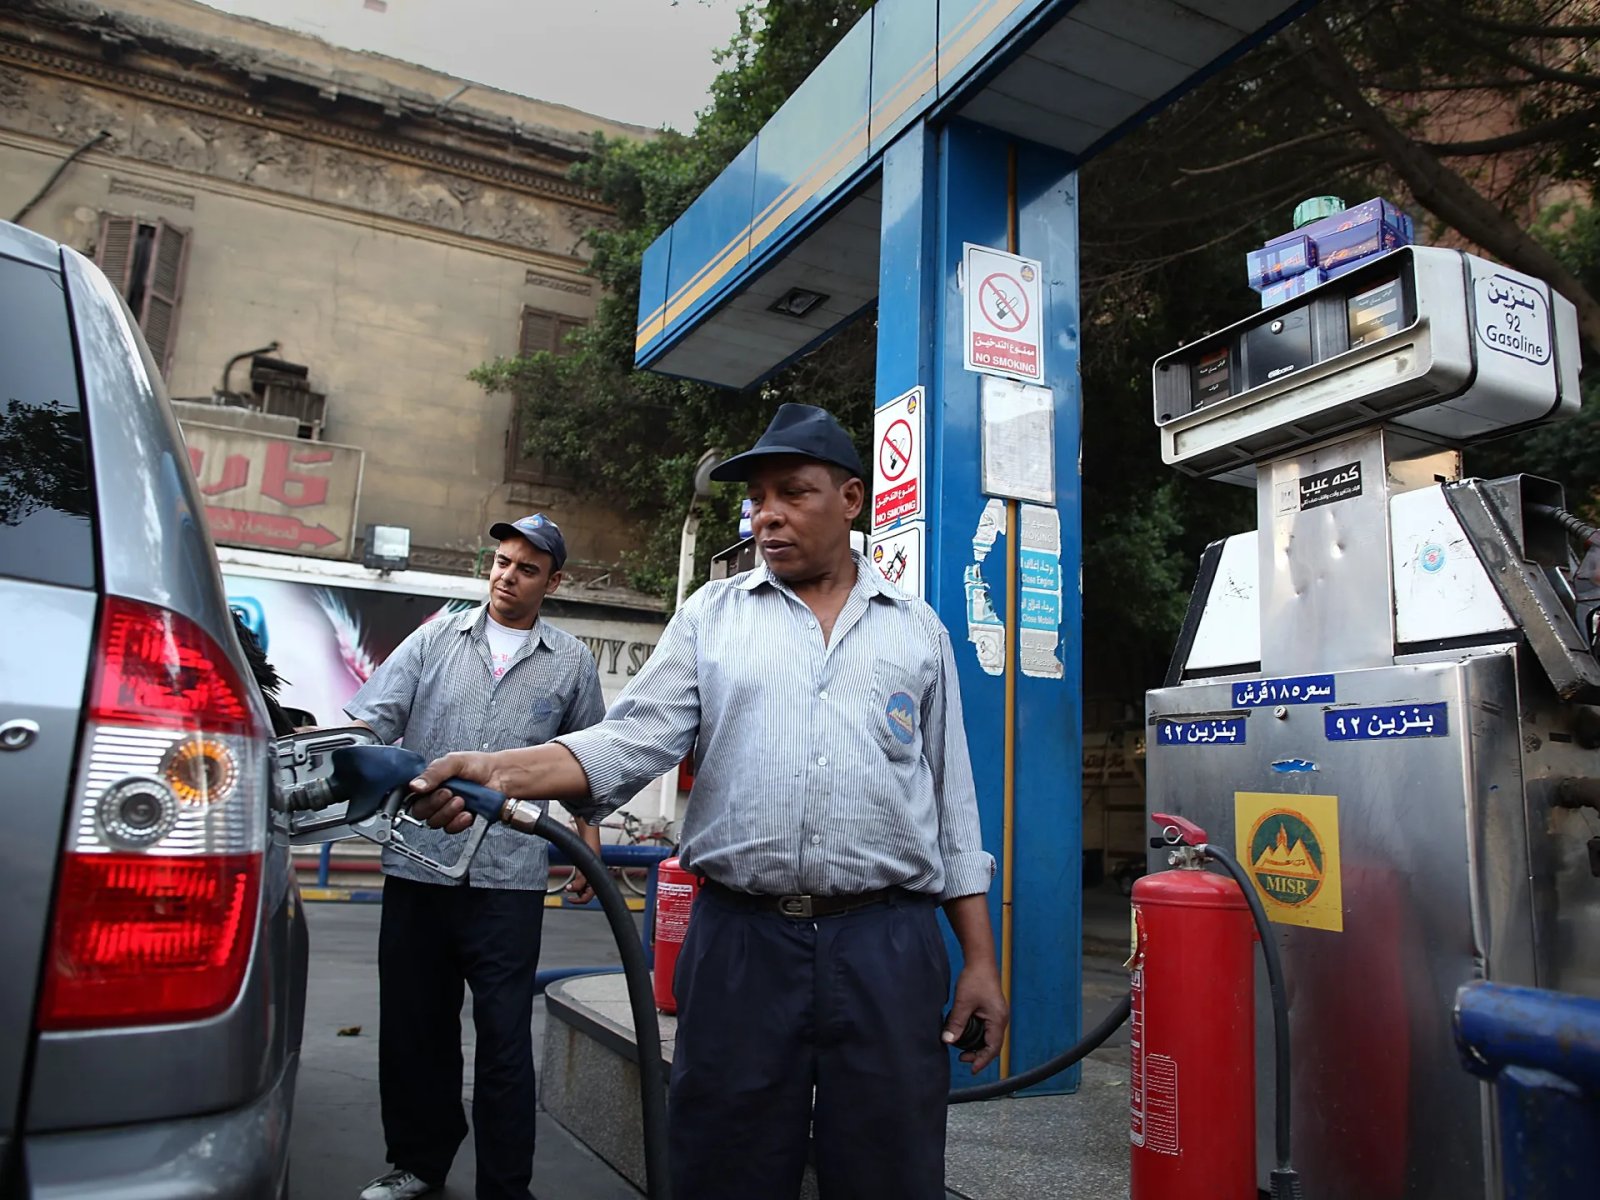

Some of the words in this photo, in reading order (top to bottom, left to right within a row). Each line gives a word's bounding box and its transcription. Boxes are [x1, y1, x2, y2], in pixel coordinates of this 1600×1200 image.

[1487, 282, 1536, 318] بنزين
[1505, 312, 1521, 333] 92
[1009, 343, 1035, 356] ممنوع
[1486, 324, 1543, 357] Gasoline
[975, 352, 991, 364] NO
[992, 355, 1036, 373] SMOKING
[1332, 465, 1359, 485] كده
[1300, 477, 1329, 497] عيب
[876, 512, 887, 524] NO
[886, 500, 916, 519] SMOKING
[1165, 724, 1183, 740] ٩٢
[1187, 720, 1236, 742] بنزين
[1336, 716, 1360, 735] ٩٢
[1368, 707, 1434, 736] بنزين
[1266, 876, 1309, 896] MISR
